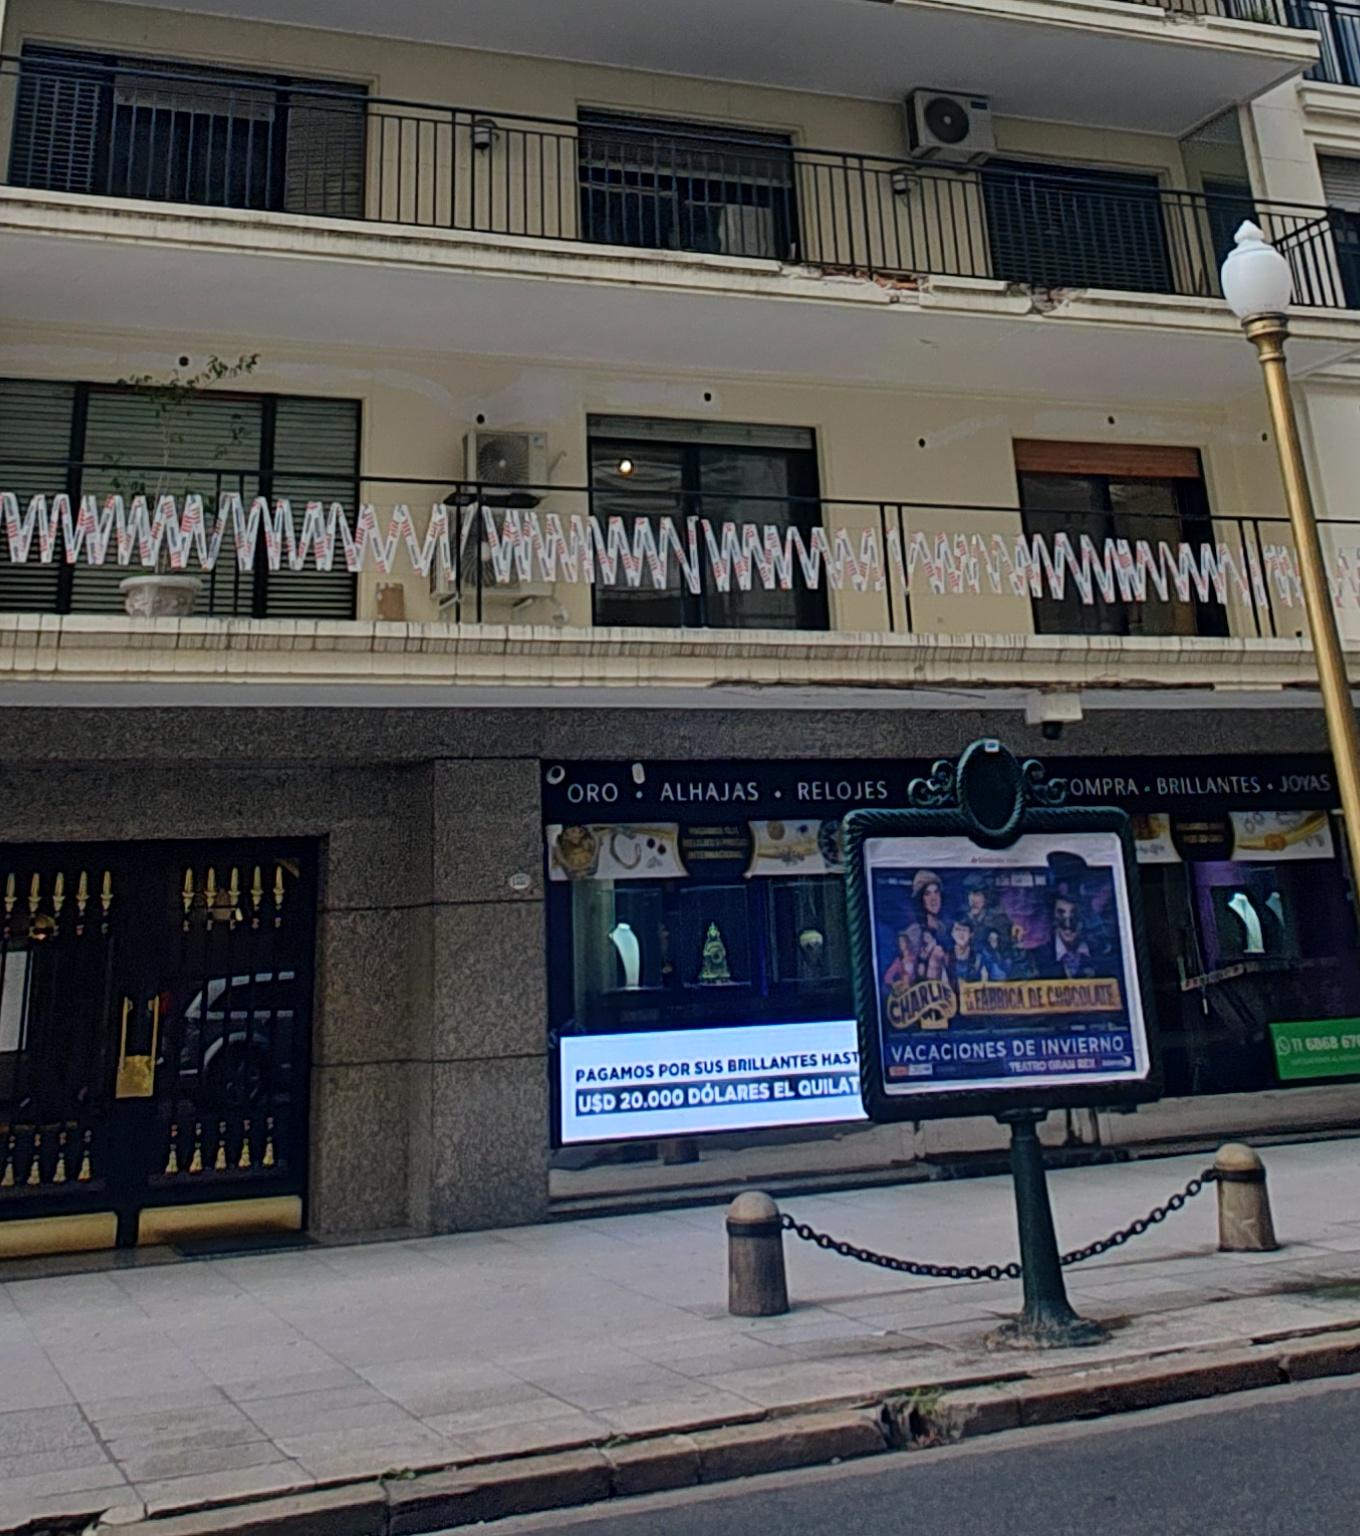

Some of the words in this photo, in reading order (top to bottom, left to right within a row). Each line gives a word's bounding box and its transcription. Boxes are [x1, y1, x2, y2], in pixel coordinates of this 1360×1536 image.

[567, 783, 619, 803] ORO
[660, 781, 760, 802] ALHAJAS
[797, 780, 889, 801] RELOJES
[1069, 777, 1139, 797] OMPRA
[1156, 776, 1261, 796] BRILLANTES
[1279, 774, 1332, 793] JOYAS
[1046, 983, 1114, 1007] CHOCOLATE
[891, 1040, 1007, 1063] VACACIONES
[1012, 1038, 1036, 1057] DE
[1041, 1035, 1125, 1056] INVIERNO
[576, 1065, 655, 1083] PAGAMOS
[658, 1062, 690, 1078] POR
[694, 1059, 724, 1075] SUS
[727, 1053, 817, 1072] BRILLANTES
[822, 1050, 859, 1065] HAST
[1008, 1060, 1046, 1073] TEATRO
[1048, 1059, 1076, 1071] GRAN
[578, 1093, 616, 1114] U$D
[619, 1088, 685, 1111] 20.000
[688, 1081, 770, 1105] DÓLARES
[773, 1080, 795, 1098] EL
[798, 1076, 859, 1096] QUILAT
